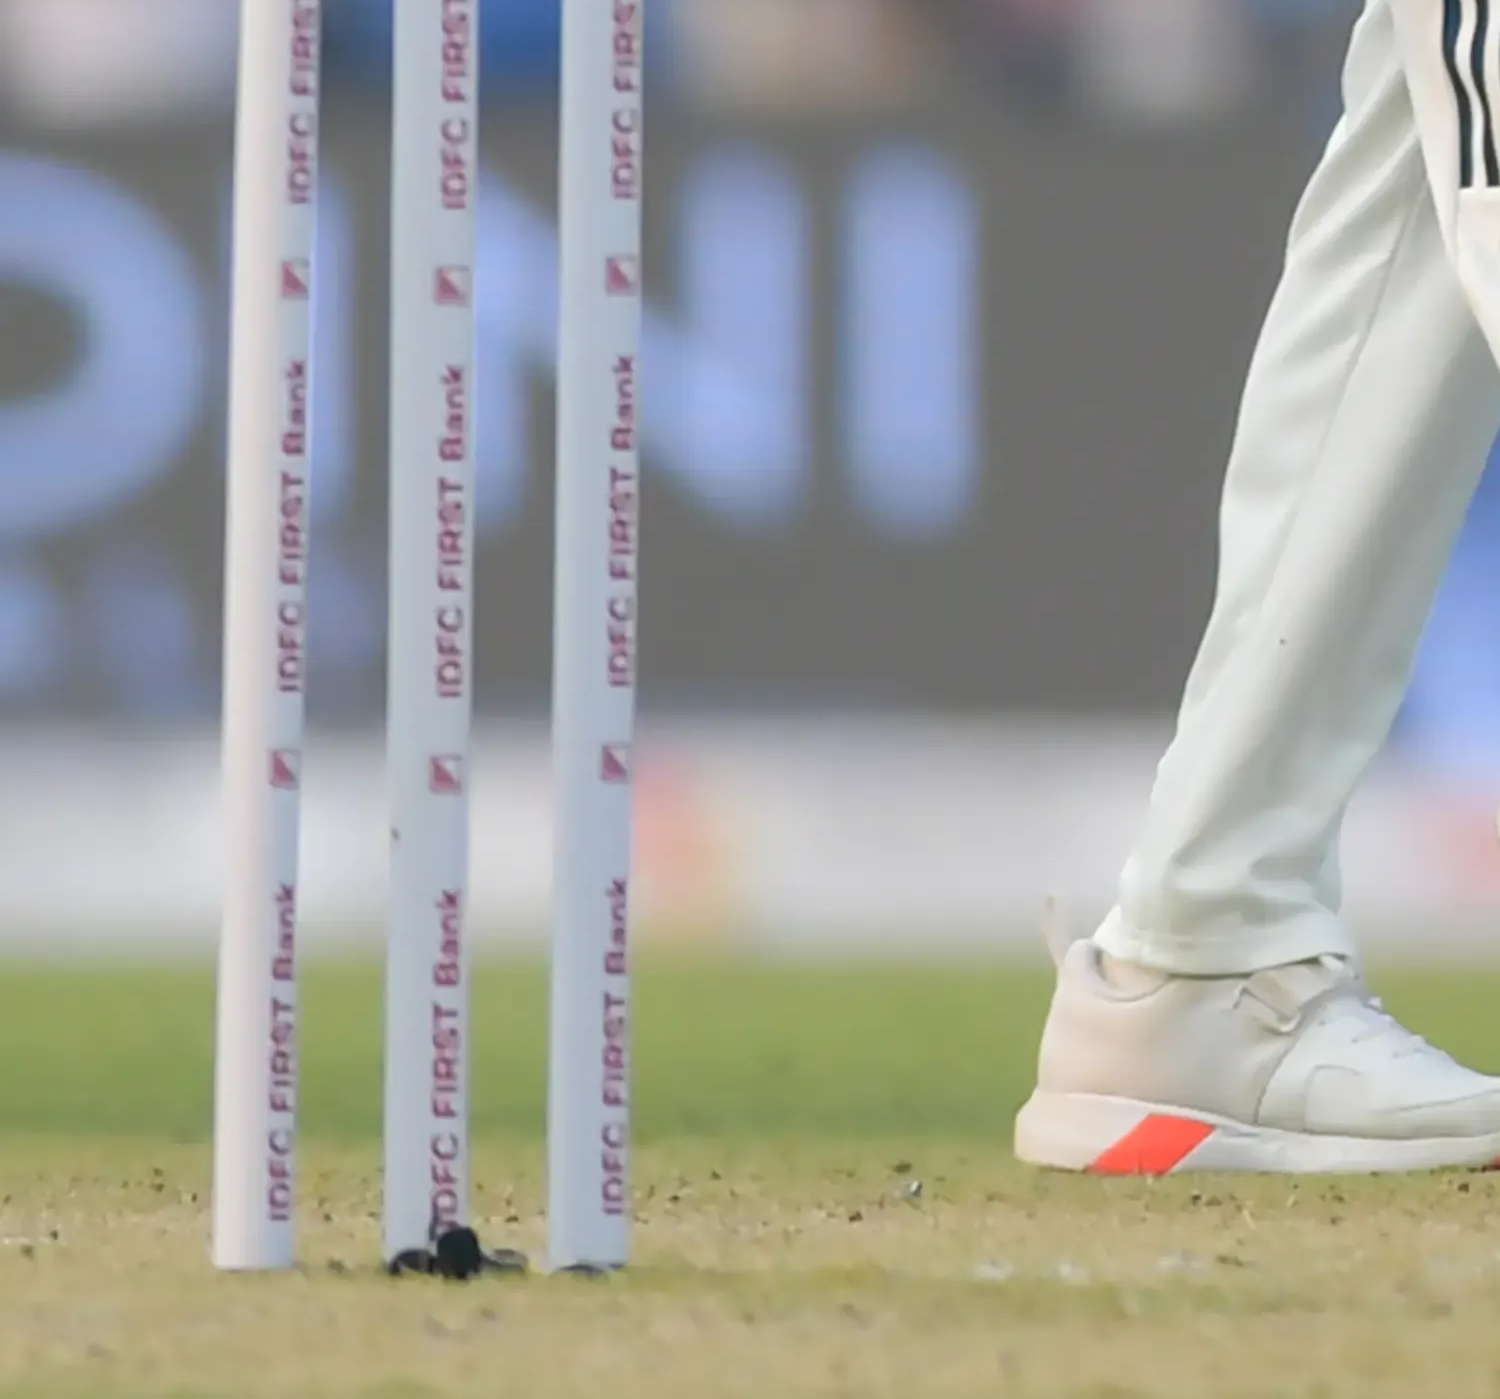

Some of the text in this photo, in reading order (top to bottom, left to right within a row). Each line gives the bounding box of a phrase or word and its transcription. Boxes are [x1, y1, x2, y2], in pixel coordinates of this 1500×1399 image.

[289, 113, 315, 205] IDFC
[442, 118, 469, 209] IDFC
[612, 108, 638, 201] IDFC
[279, 471, 306, 585] FIRST
[436, 365, 466, 698] IDFC FIRST Bank
[607, 355, 636, 688] IDFC FIRST Bank
[277, 601, 304, 693] IDFC
[433, 887, 462, 988] Bank
[269, 998, 294, 1112] FIRST
[431, 1001, 460, 1119] FIRST
[601, 877, 629, 1216] IDFC FIRST Bank
[267, 1128, 294, 1222] IDFC
